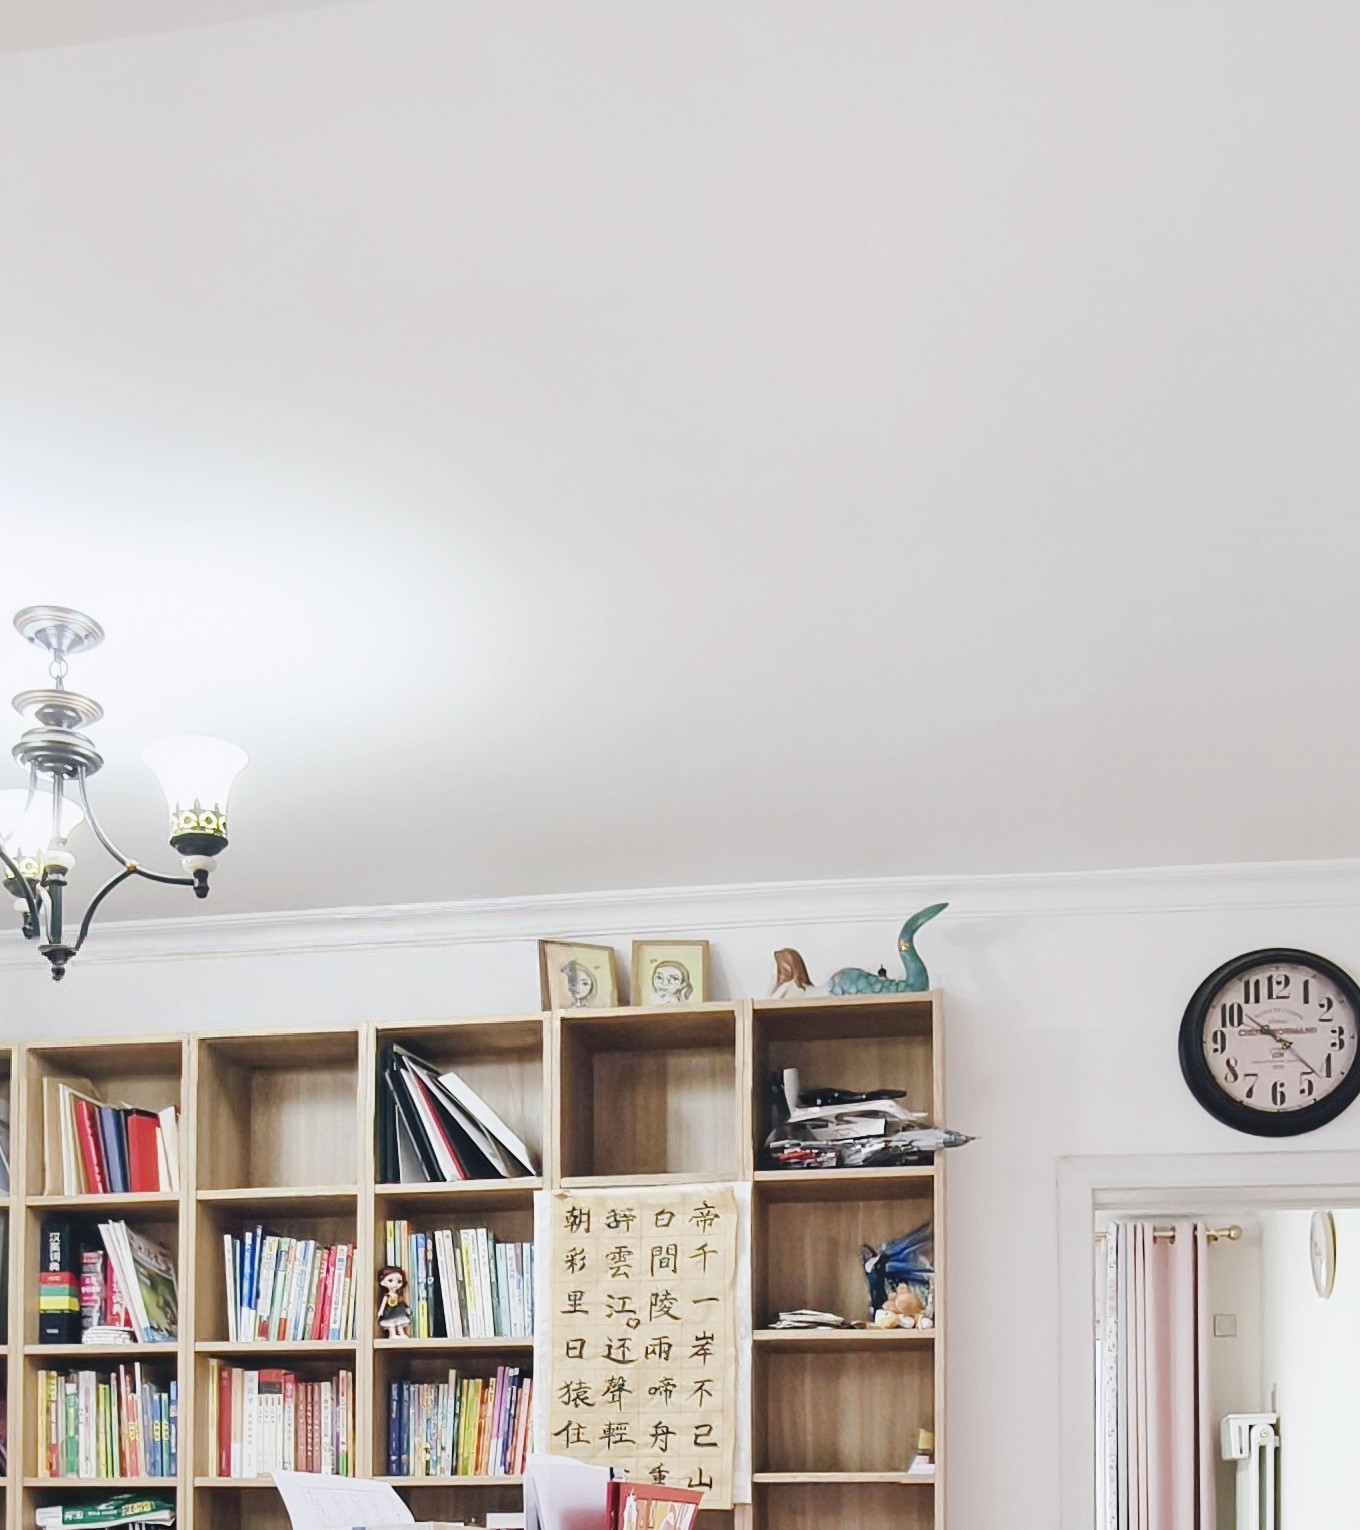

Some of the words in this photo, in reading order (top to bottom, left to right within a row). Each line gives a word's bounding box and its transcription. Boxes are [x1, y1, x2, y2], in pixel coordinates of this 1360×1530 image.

[1243, 979, 1260, 1004] 11
[1267, 974, 1291, 1000] 12
[1303, 979, 1310, 1004] 1
[1221, 1002, 1243, 1027] 10
[1319, 997, 1333, 1022] 2
[1212, 1029, 1226, 1054] 9
[1330, 1026, 1345, 1051] 3
[1225, 1057, 1238, 1083] 8
[1300, 1068, 1314, 1097] 5
[1244, 1074, 1258, 1098] 7
[1272, 1080, 1286, 1106] 6
